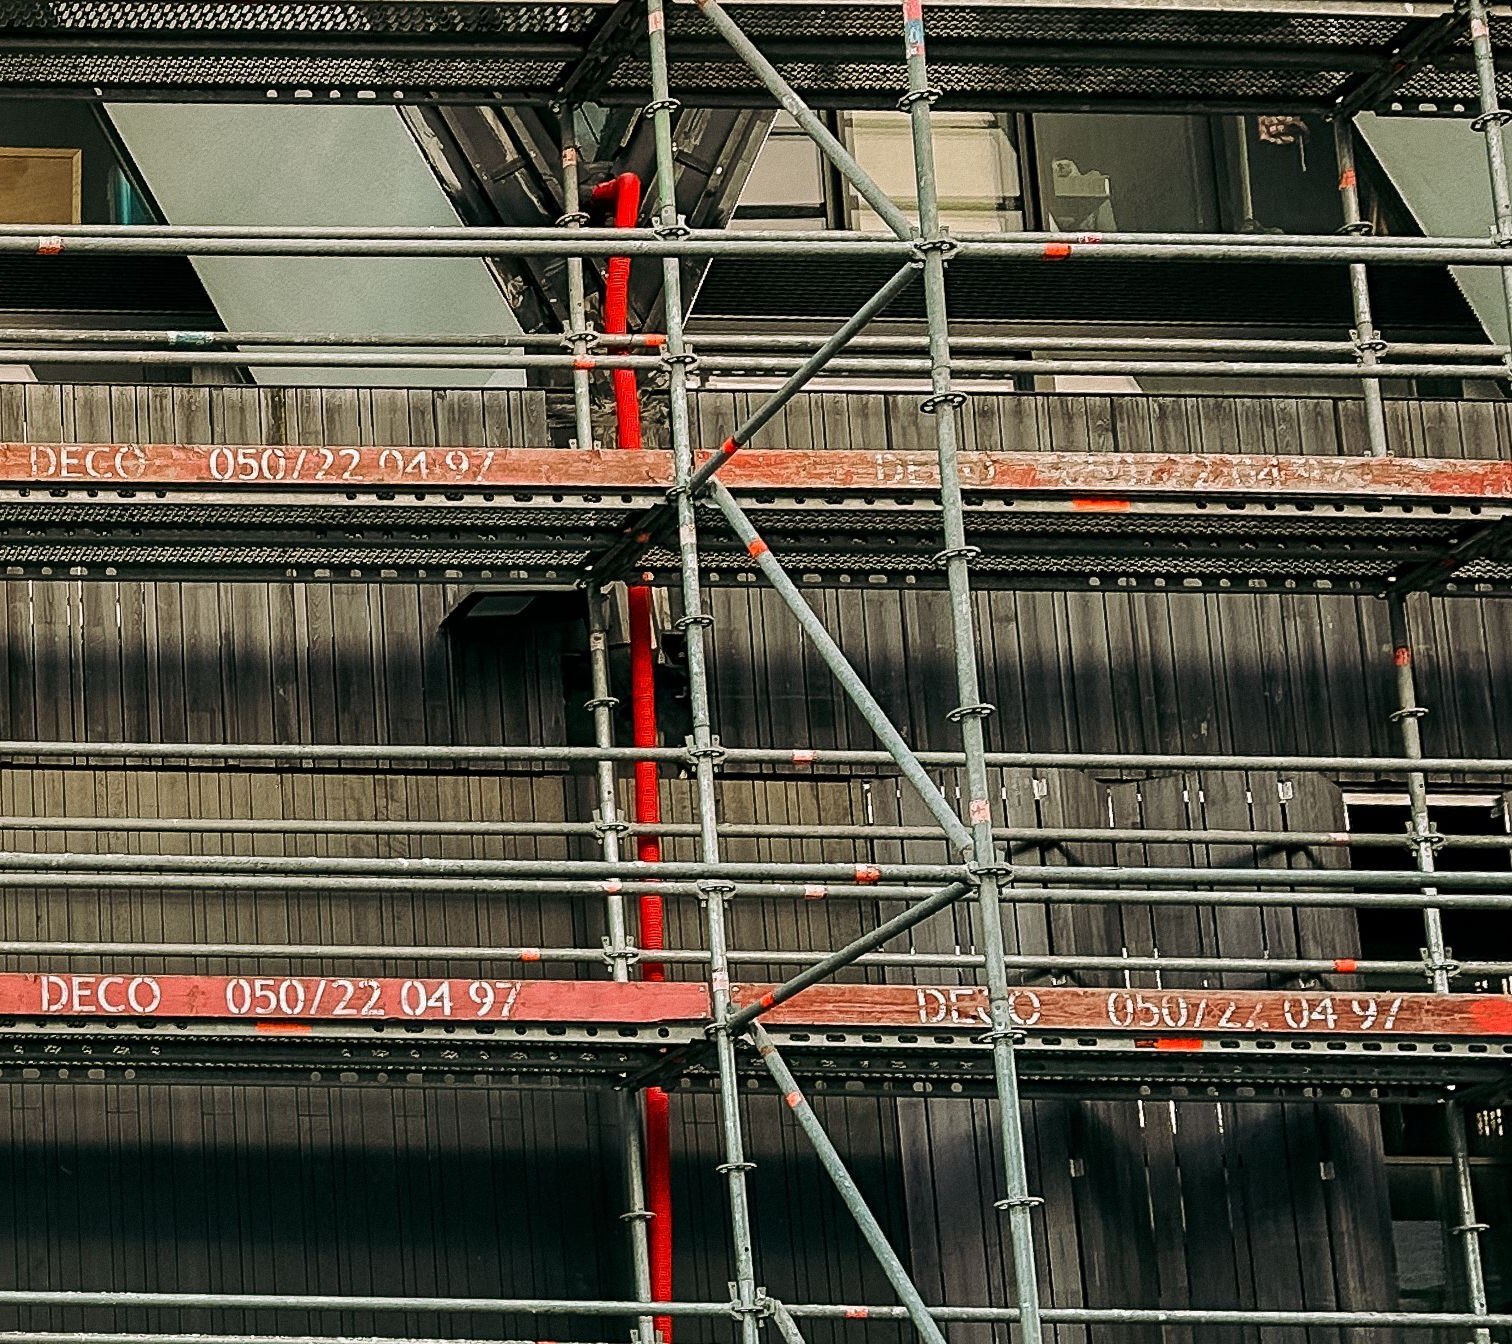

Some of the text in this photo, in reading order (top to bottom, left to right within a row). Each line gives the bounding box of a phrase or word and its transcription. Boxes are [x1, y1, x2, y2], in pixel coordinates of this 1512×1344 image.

[30, 447, 145, 479] DECO
[210, 447, 364, 480] 050/22
[379, 450, 429, 480] 04
[40, 976, 522, 1017] DECO 050/22 04 97
[1284, 996, 1338, 1030] 04
